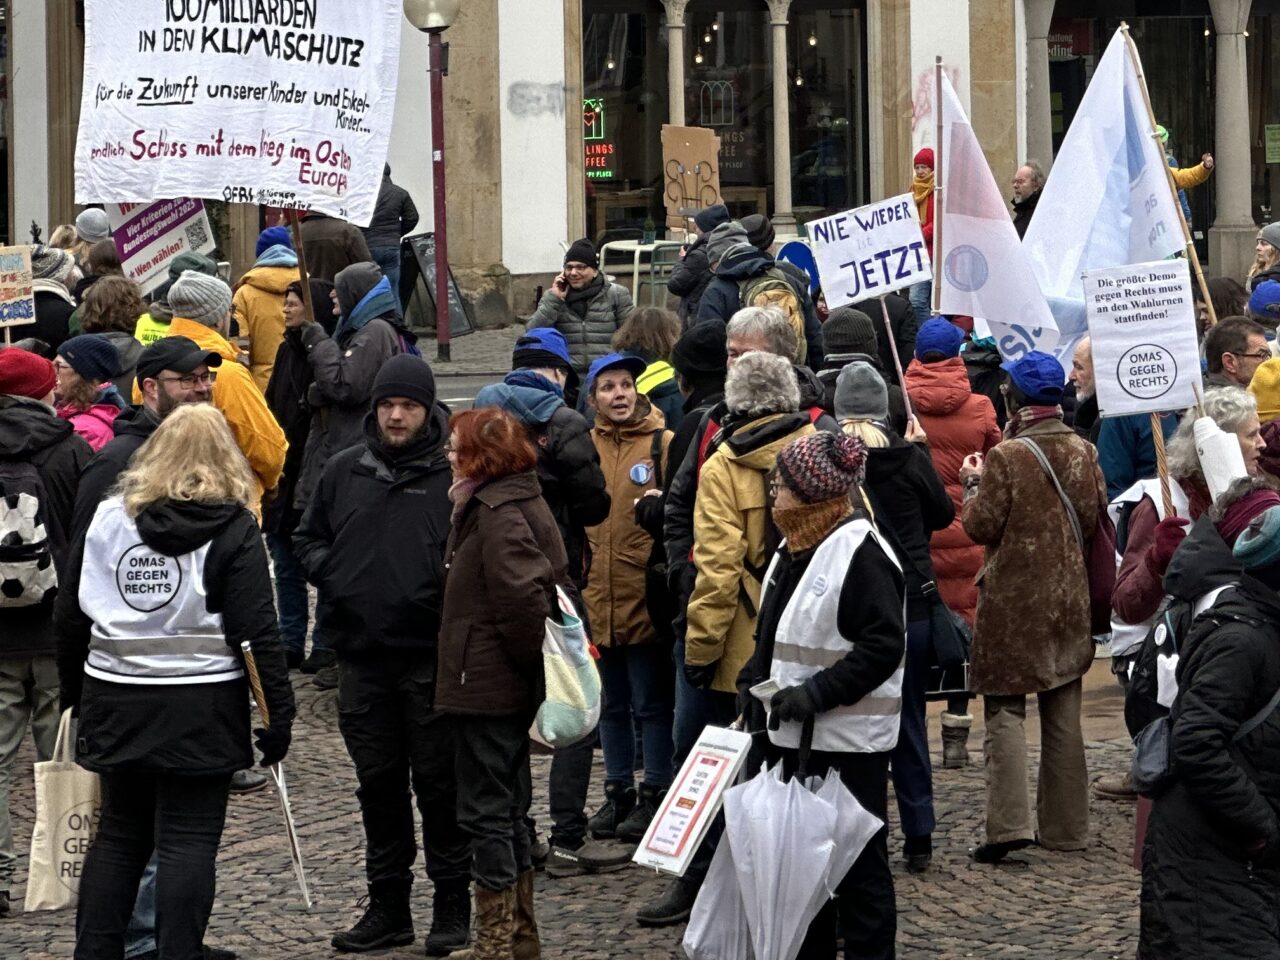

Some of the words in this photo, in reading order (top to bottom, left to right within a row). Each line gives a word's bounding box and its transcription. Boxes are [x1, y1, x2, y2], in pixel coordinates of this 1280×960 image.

[138, 29, 156, 53] IN
[163, 27, 194, 53] DEN
[200, 26, 365, 68] KLIMASCHUTZ
[95, 82, 114, 109] für
[117, 82, 133, 99] die
[137, 75, 198, 102] Zukunft
[207, 84, 268, 101] unserer
[314, 89, 340, 107] und
[91, 141, 125, 160] endlich
[196, 128, 224, 157] mit
[228, 137, 256, 157] dem
[290, 138, 310, 162] im
[585, 143, 614, 155] LINGS
[585, 156, 607, 167] FFEE
[123, 210, 178, 254] Bundestagswahl
[178, 200, 196, 218] 2025
[126, 223, 141, 238] Vier
[140, 203, 173, 230] Kriterien
[813, 217, 850, 244] NIE
[854, 201, 912, 232] WIEDER
[134, 262, 152, 277] Wen
[152, 238, 184, 267] wählen?
[840, 241, 924, 298] JETZT
[1097, 279, 1114, 288] Die
[1116, 274, 1147, 288] größte
[1149, 273, 1177, 284] Demo
[1094, 292, 1122, 303] gegen
[1124, 287, 1156, 298] Rechts
[1158, 284, 1183, 294] muss
[1096, 304, 1109, 313] an
[1111, 302, 1128, 312] den
[1130, 297, 1184, 309] Wahlurnen
[1114, 310, 1169, 324] stattfinden!
[1129, 351, 1162, 364] OMAS
[1129, 364, 1165, 376] GEGEN
[1128, 376, 1169, 389] RECHTS
[129, 556, 166, 568] OMAS
[126, 570, 169, 581] GEGEN
[124, 583, 172, 594] RECHTS
